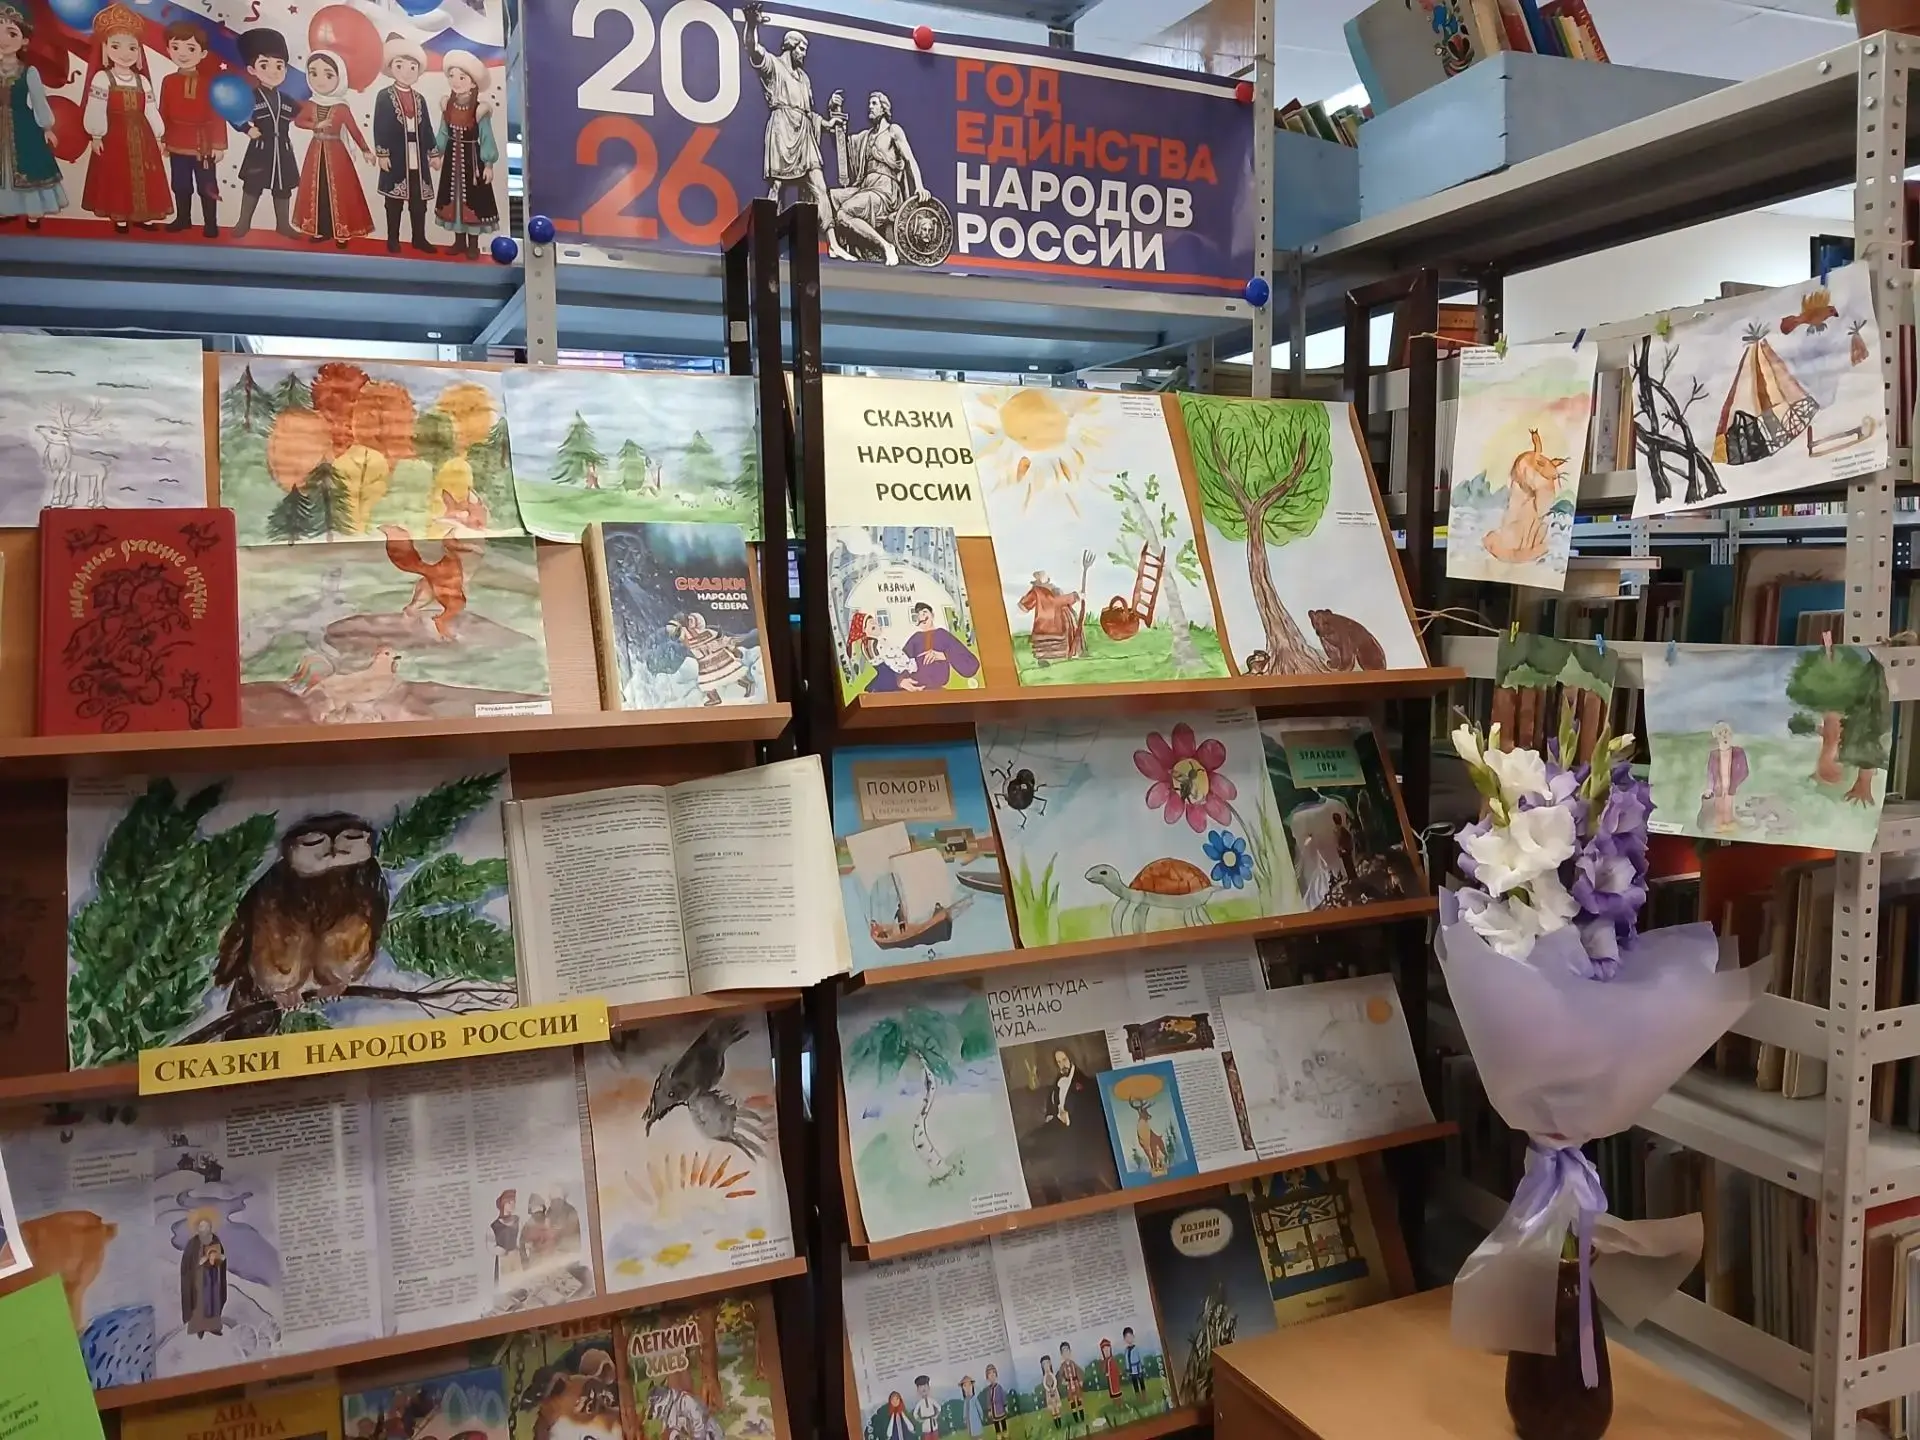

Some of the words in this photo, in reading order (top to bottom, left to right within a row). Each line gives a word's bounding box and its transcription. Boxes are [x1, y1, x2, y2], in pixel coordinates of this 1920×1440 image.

[572, 0, 741, 124] 20
[956, 58, 1062, 120] ГОД
[956, 110, 1218, 185] ЕДИНСТВА
[576, 116, 739, 247] 26
[956, 162, 1193, 229] НАРОДОВ
[957, 211, 1165, 271] РОССИИ
[863, 408, 954, 429] СКАЗКИ
[857, 445, 974, 469] НАРОДОВ
[876, 483, 972, 502] РОССИИ
[675, 576, 747, 591] СКАЗКИ
[877, 582, 916, 592] КАЗАЧЬИ
[697, 592, 747, 601] НАРОДОВ
[711, 602, 749, 610] СЕВЕРА
[886, 595, 912, 603] СКАЗКИ
[867, 779, 941, 796] ПОМОРЫ
[987, 985, 1043, 1006] ПОЙТИ
[1046, 978, 1089, 996] ТУДА
[990, 1006, 1012, 1022] НЕ
[1016, 998, 1063, 1019] ЗНАЮ
[994, 1020, 1047, 1039] КУДА...
[154, 1050, 281, 1083] СКАЗКИ
[305, 1030, 448, 1066] НАРОДОВ
[461, 1013, 580, 1047] РОССИИ
[1181, 1228, 1221, 1245] ВЕТРОВ
[646, 1351, 688, 1374] ХЛЕБ
[213, 1402, 258, 1425] ДВА
